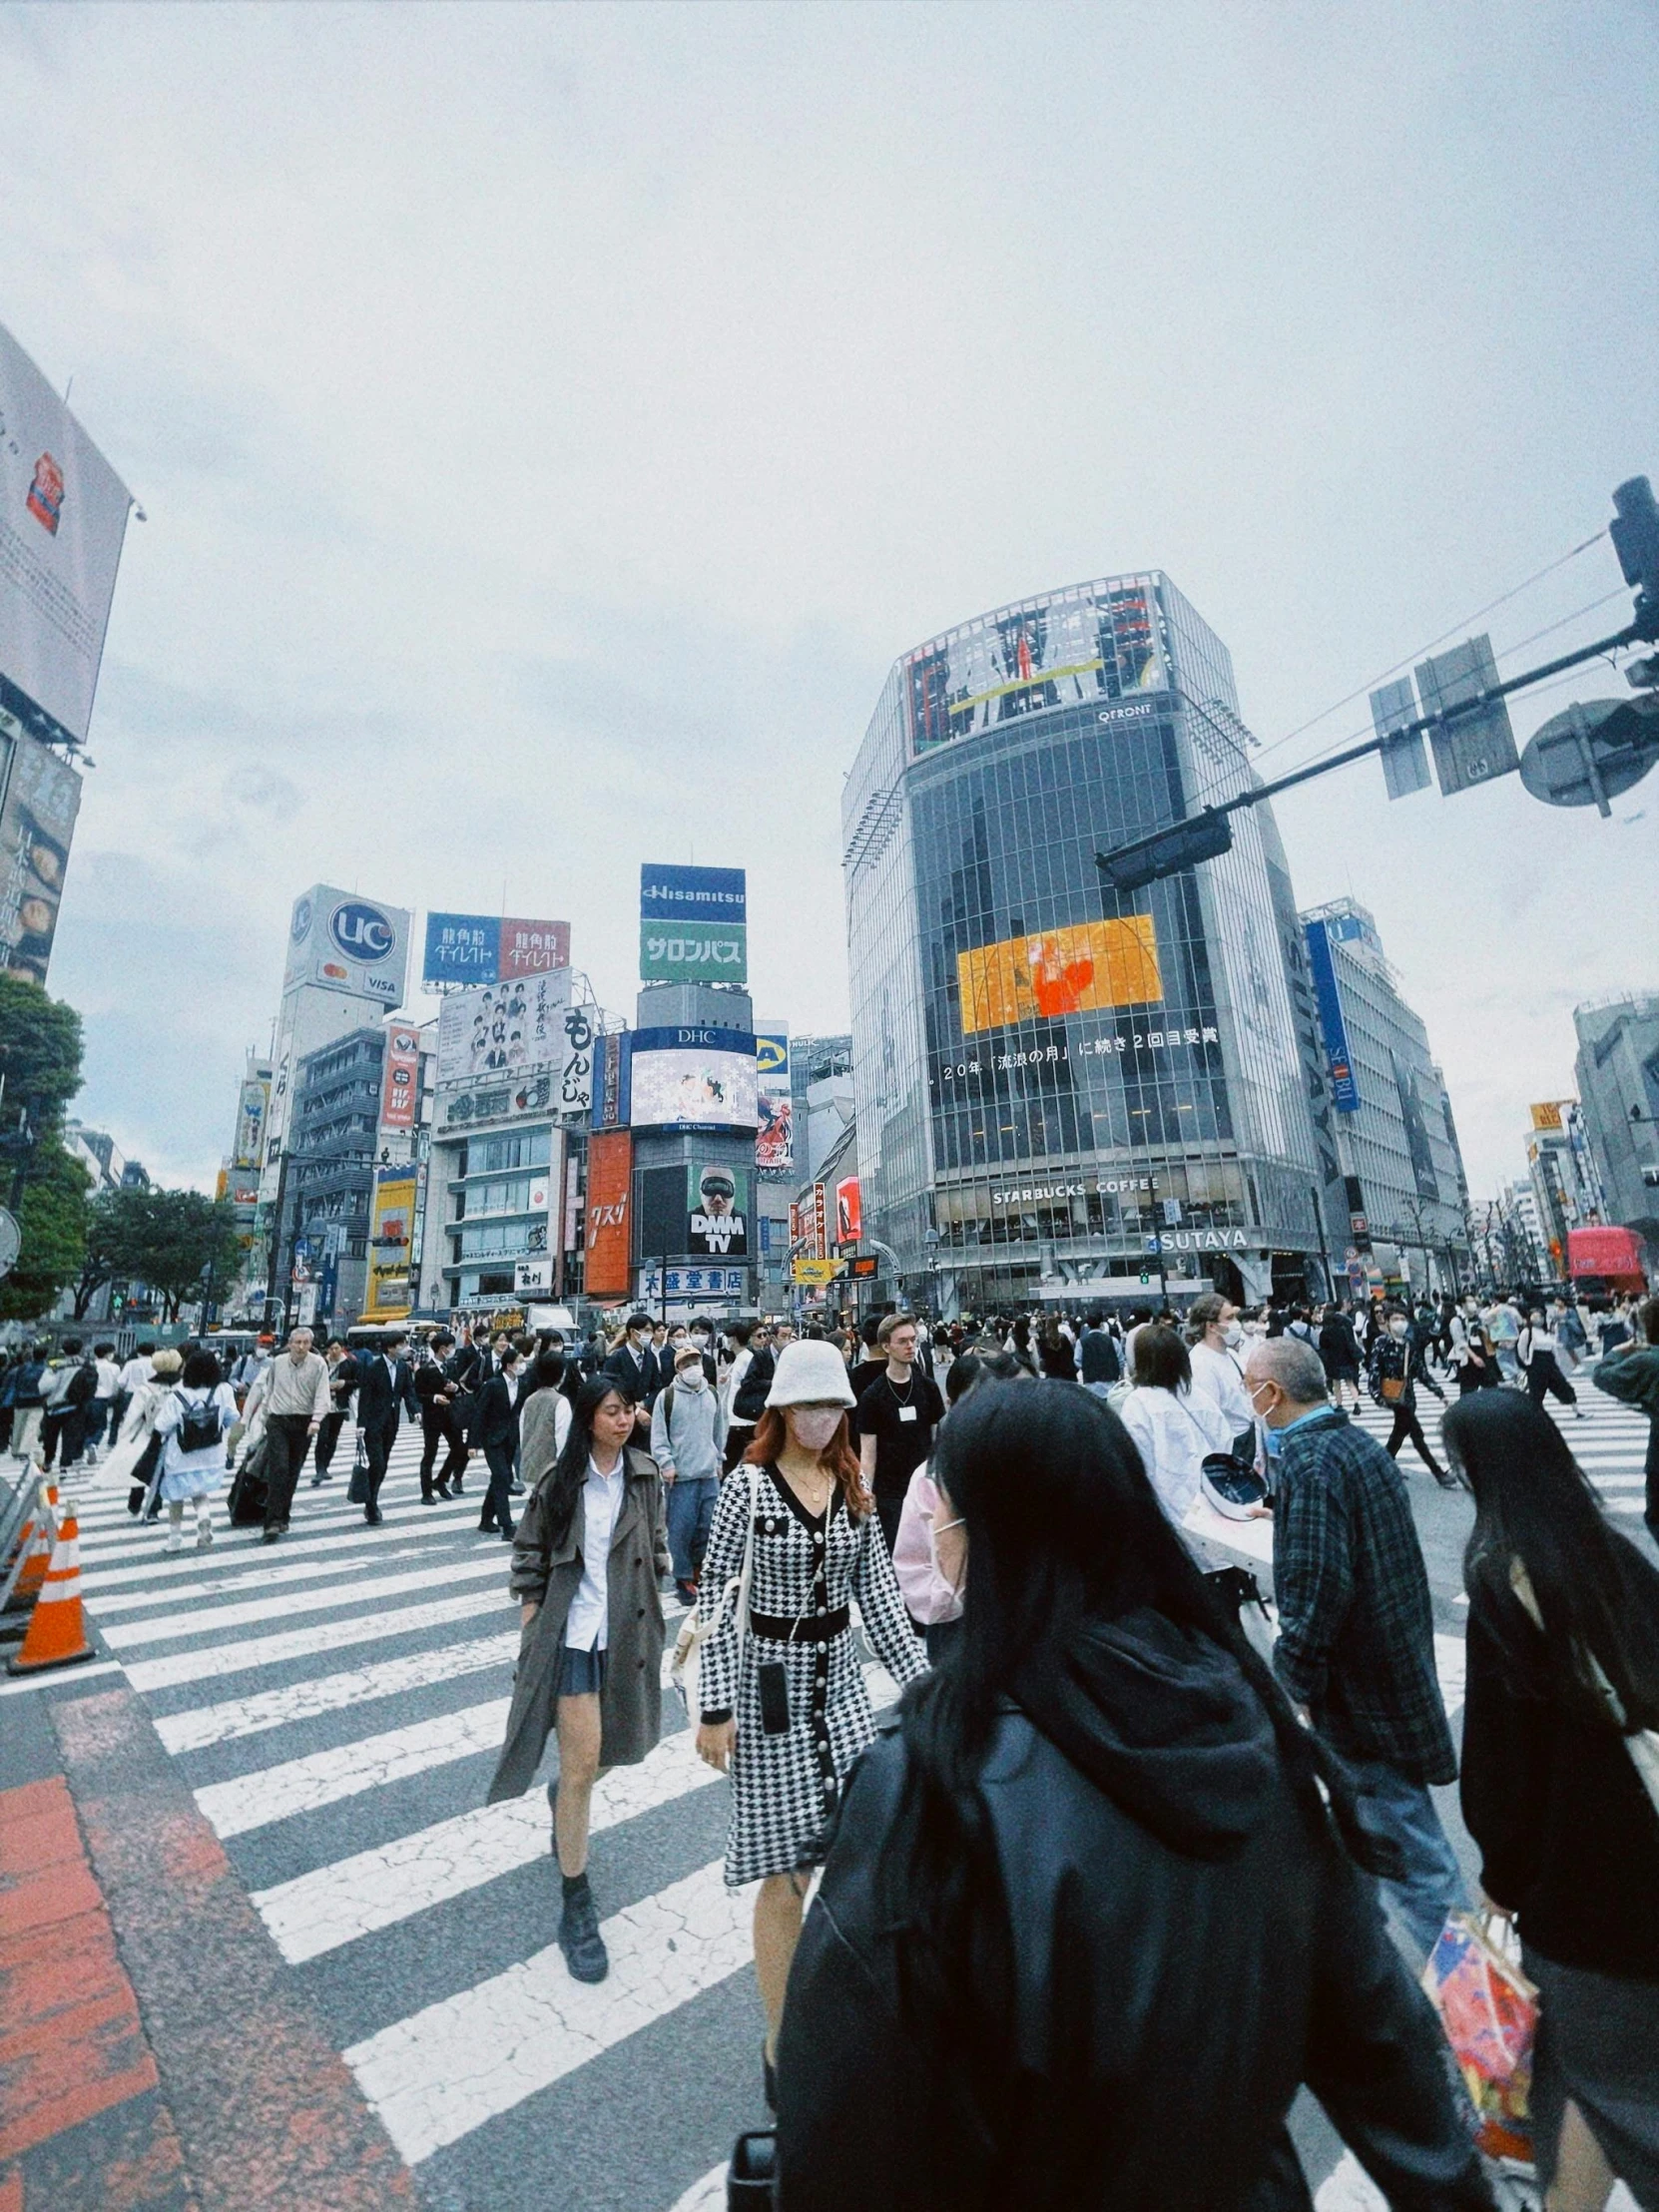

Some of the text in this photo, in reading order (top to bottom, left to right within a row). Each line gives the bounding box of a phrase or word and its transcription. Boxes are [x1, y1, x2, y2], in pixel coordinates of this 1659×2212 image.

[1098, 703, 1152, 724] QFRONT
[643, 884, 745, 904] Hisamitsu
[337, 910, 391, 949] UC
[442, 927, 486, 946] 龍角散
[515, 931, 557, 950] 龍角散
[647, 938, 742, 964] サロンパス
[368, 976, 395, 993] VISA
[678, 1029, 717, 1044] DHC
[562, 1008, 592, 1107] もんじゃ
[1329, 1047, 1353, 1101] SEIBU
[993, 1177, 1160, 1205] STARBUCKS COFFEE
[691, 1215, 745, 1235] DMM
[705, 1234, 731, 1253] TV
